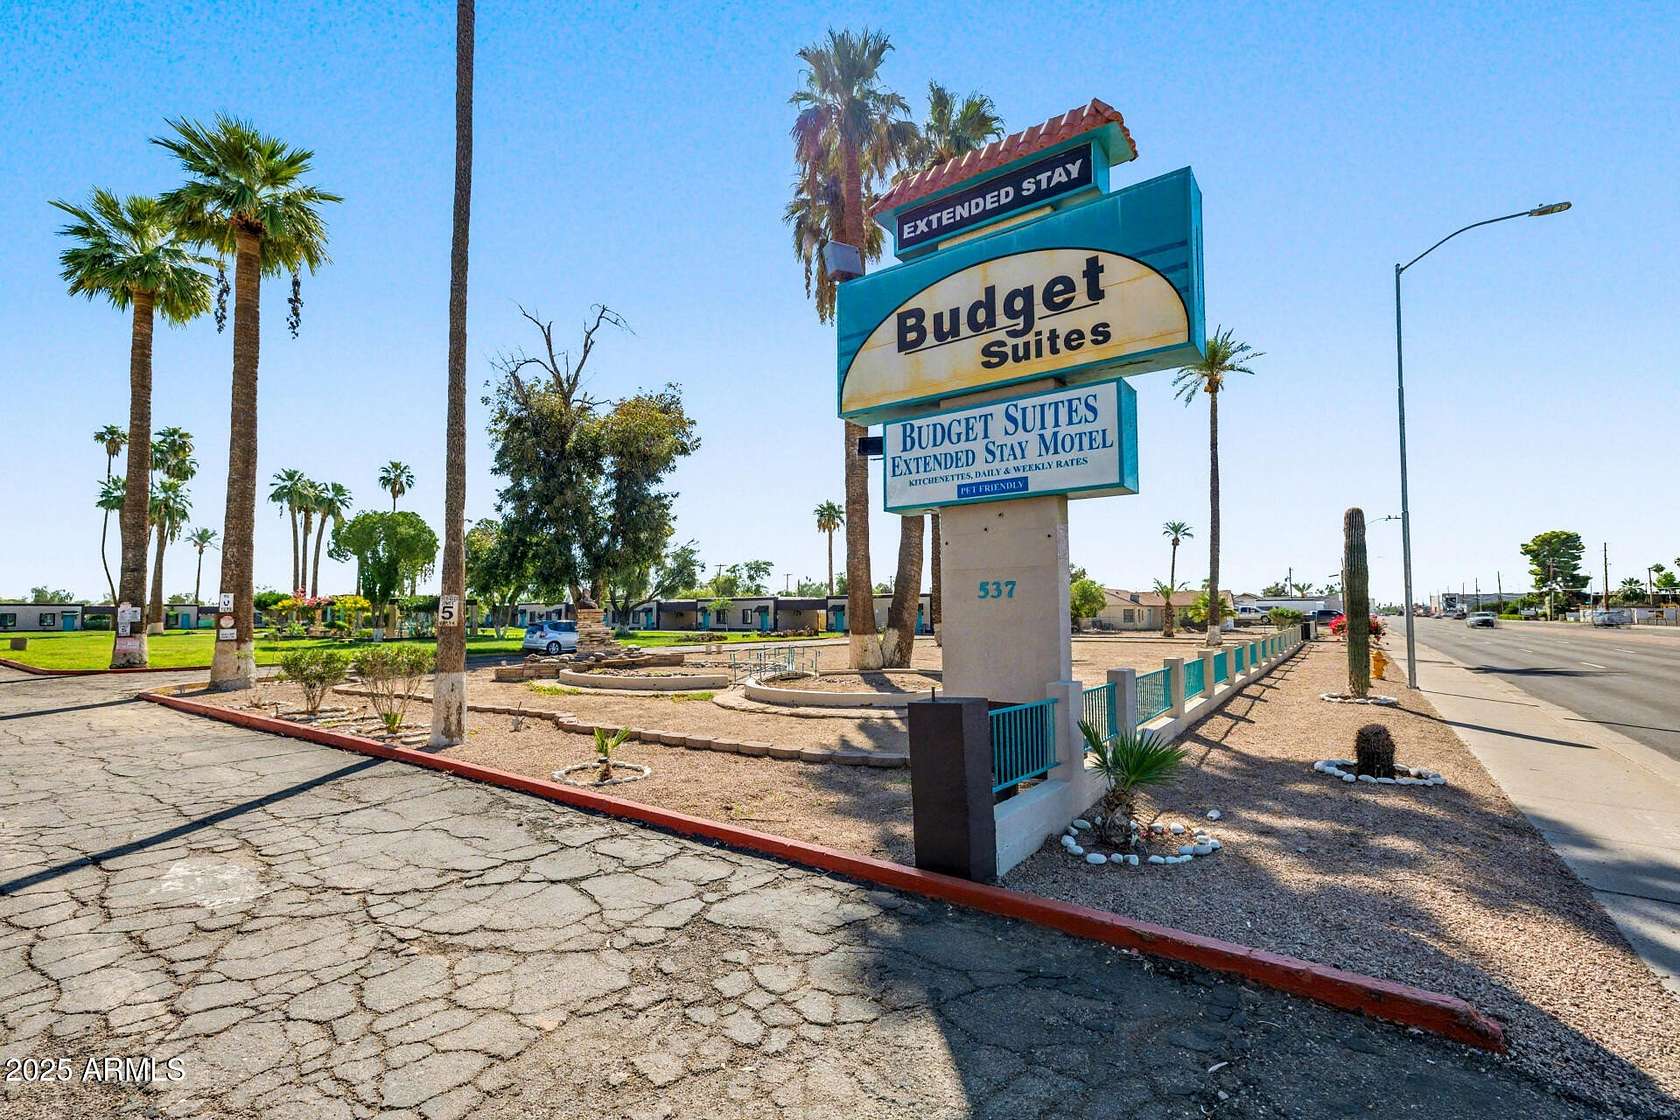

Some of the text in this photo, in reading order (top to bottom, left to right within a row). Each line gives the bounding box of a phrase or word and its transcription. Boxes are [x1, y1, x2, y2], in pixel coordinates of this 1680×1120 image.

[903, 159, 1083, 239] EXTENDED STAY
[897, 255, 1106, 353] Budget
[981, 321, 1112, 369] Suites
[900, 393, 1098, 453] BUDGET SUITES
[890, 428, 1114, 478] EXTENDED STAY MOTEL
[909, 456, 1088, 487] KITCHENETTES, DAILY & WEEKLY RATES
[960, 481, 1025, 495] PET FRIENDLY
[441, 605, 454, 620] 5
[977, 580, 1016, 599] 537
